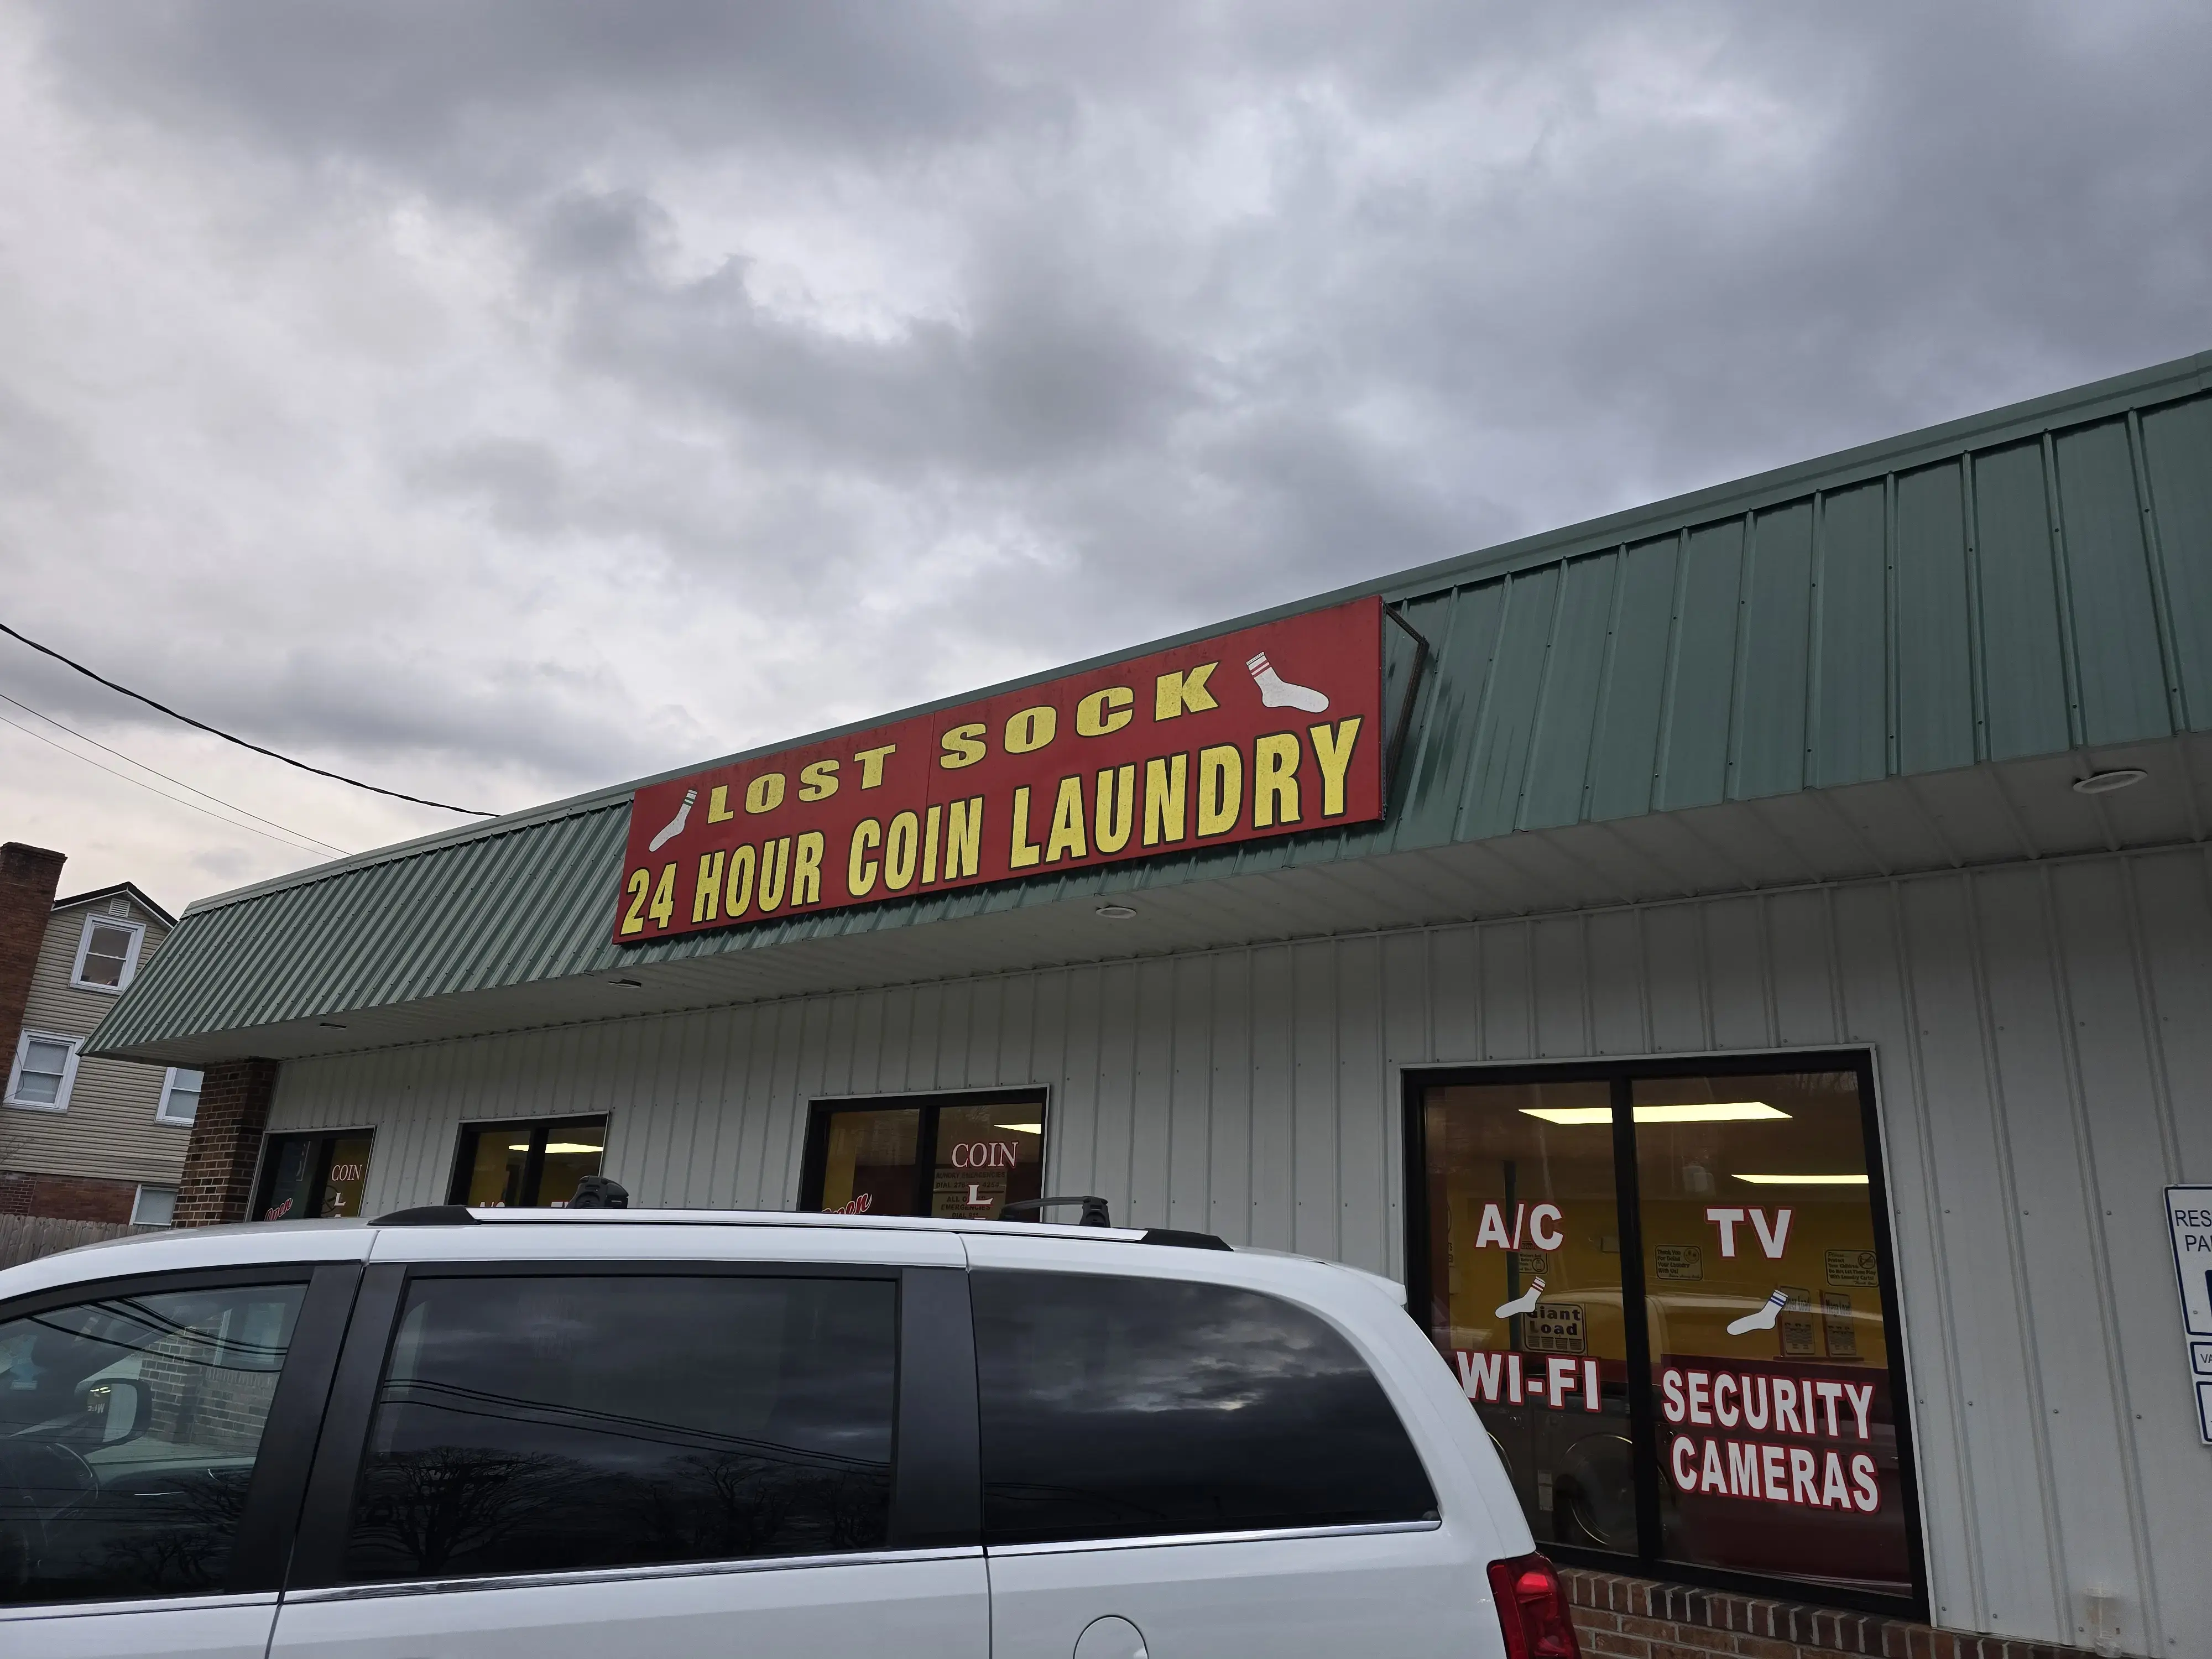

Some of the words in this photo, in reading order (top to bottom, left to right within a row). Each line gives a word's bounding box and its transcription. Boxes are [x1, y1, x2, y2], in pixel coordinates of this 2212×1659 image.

[707, 745, 896, 824] LOST
[940, 662, 1219, 769] SOCK
[620, 863, 677, 935] 24
[692, 831, 824, 922] HOUR
[848, 797, 983, 896] COIN
[1010, 717, 1361, 868] LAUNDRY
[331, 1164, 363, 1181] COIN
[951, 1142, 1019, 1167] COIN
[1475, 1203, 1564, 1251] A/C
[1706, 1208, 1792, 1259] TV
[1529, 1320, 1578, 1335] Load
[1455, 1351, 1599, 1411] WI-FI
[1662, 1369, 1874, 1439] SECURITY
[1672, 1436, 1879, 1512] CAMERAS
